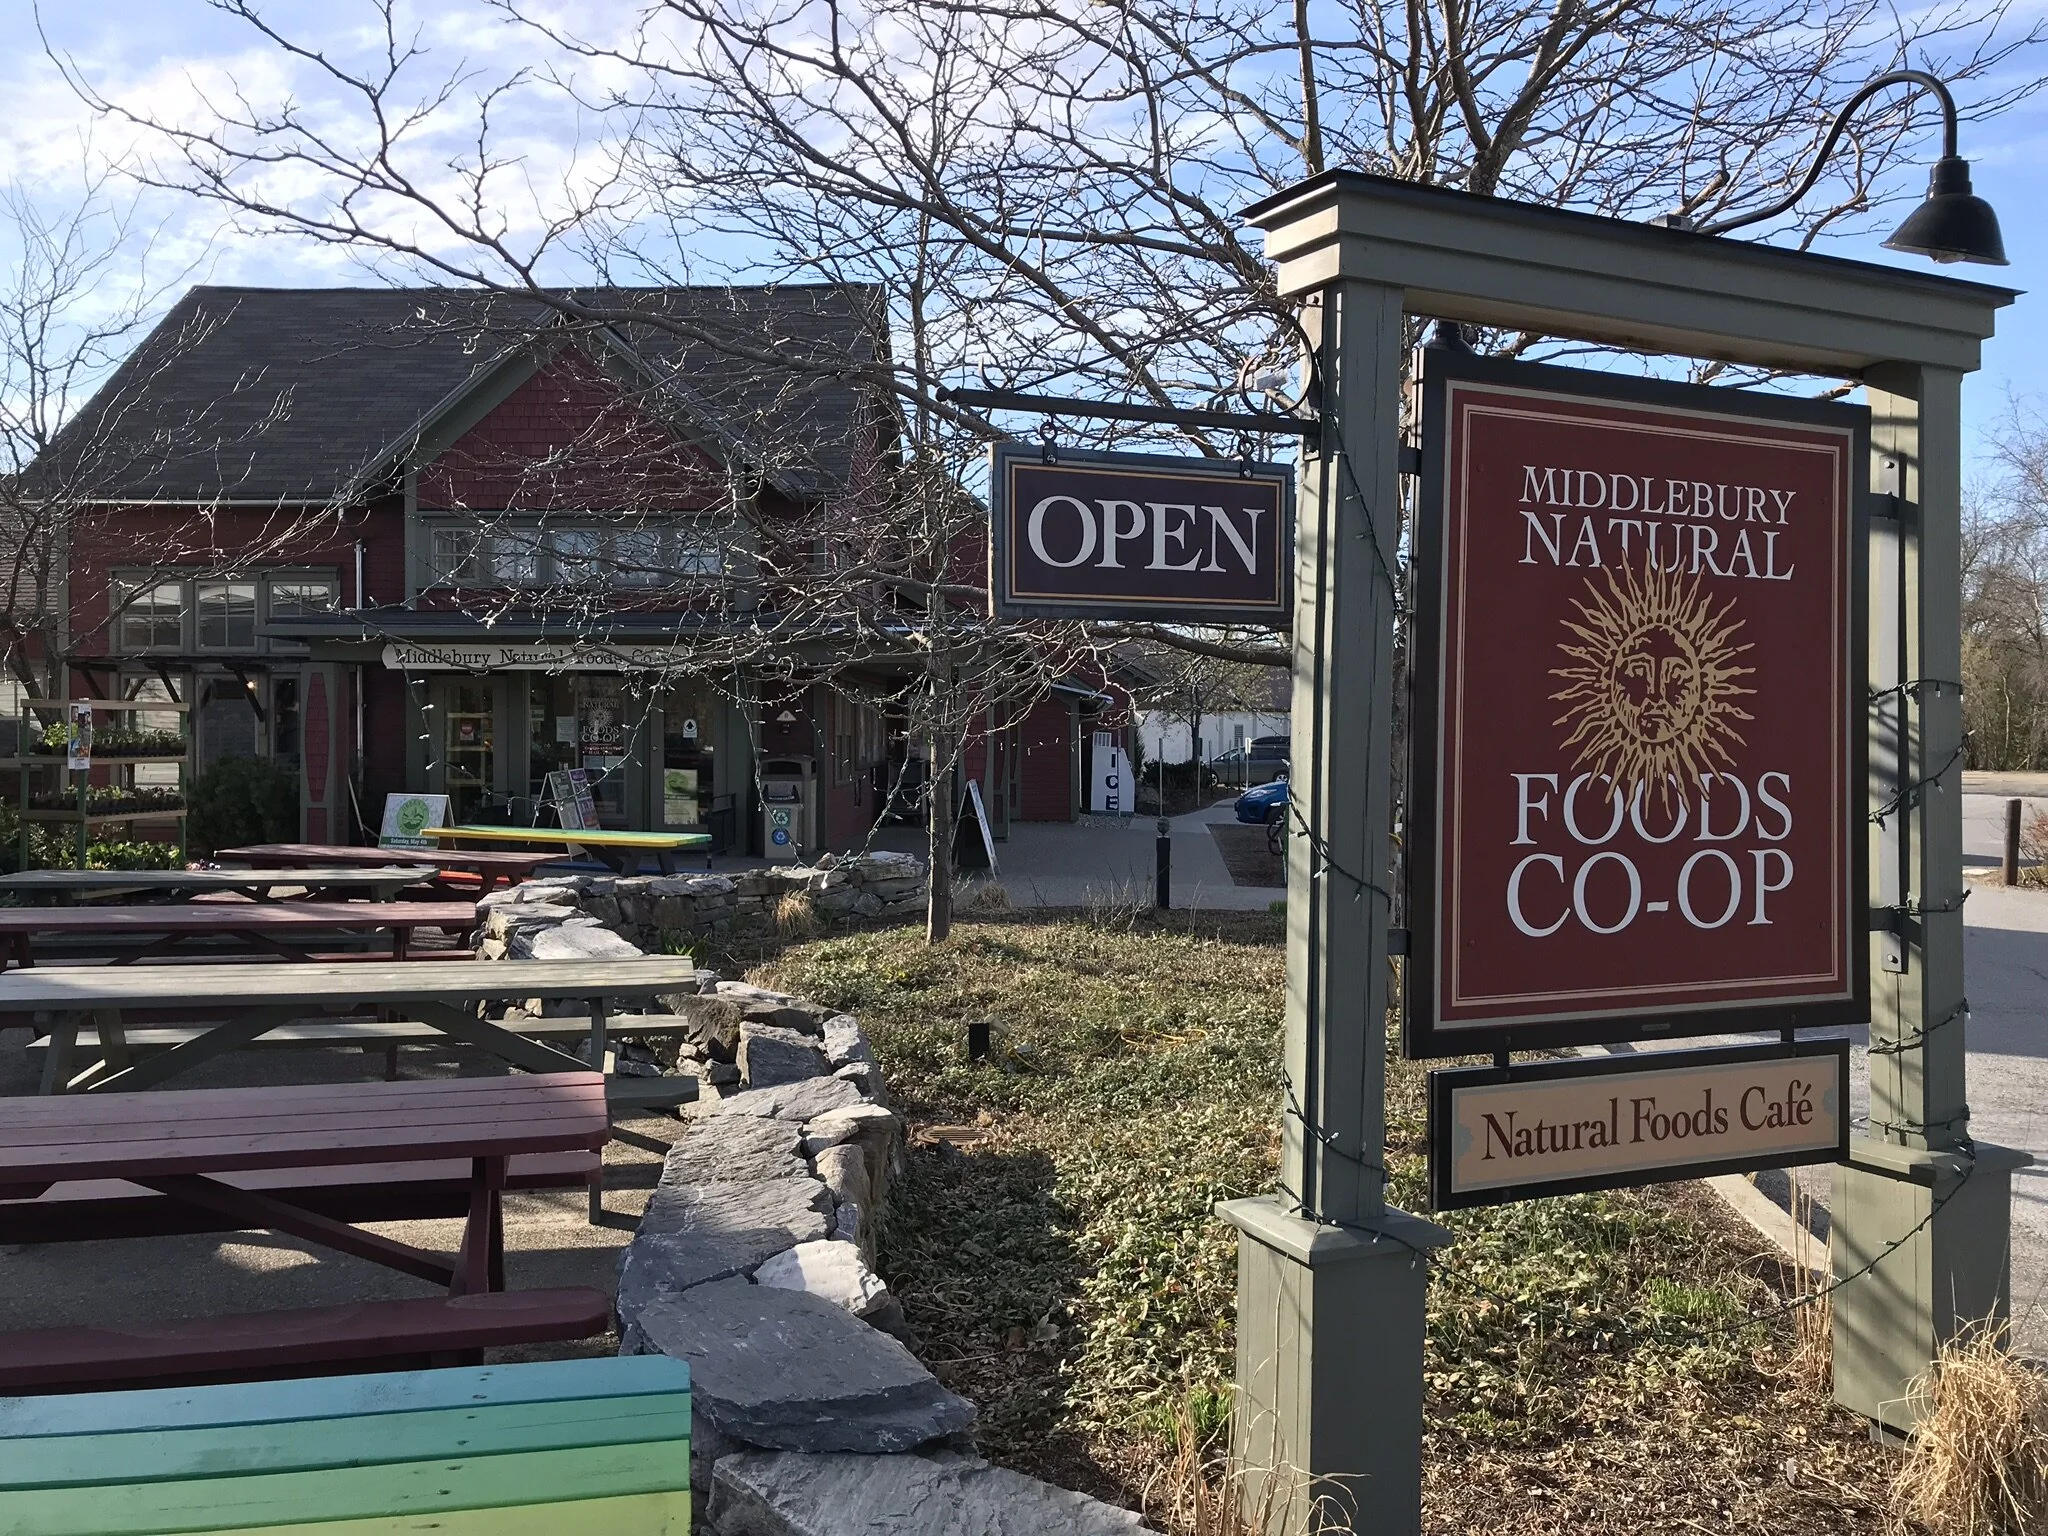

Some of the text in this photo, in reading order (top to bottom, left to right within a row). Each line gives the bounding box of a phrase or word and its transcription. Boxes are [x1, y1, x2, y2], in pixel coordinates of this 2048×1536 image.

[1518, 465, 1797, 525] MIDDLEBURY
[1027, 495, 1266, 575] OPEN
[1518, 510, 1796, 581] NATURAL
[395, 648, 491, 667] Middlebury
[581, 733, 621, 743] CO-OP
[583, 725, 620, 734] FOODS
[1105, 753, 1118, 810] ICE
[1509, 771, 1793, 845] FOODS
[1507, 848, 1794, 938] CO-OP
[1481, 1079, 1813, 1160] Natural Foods Café
